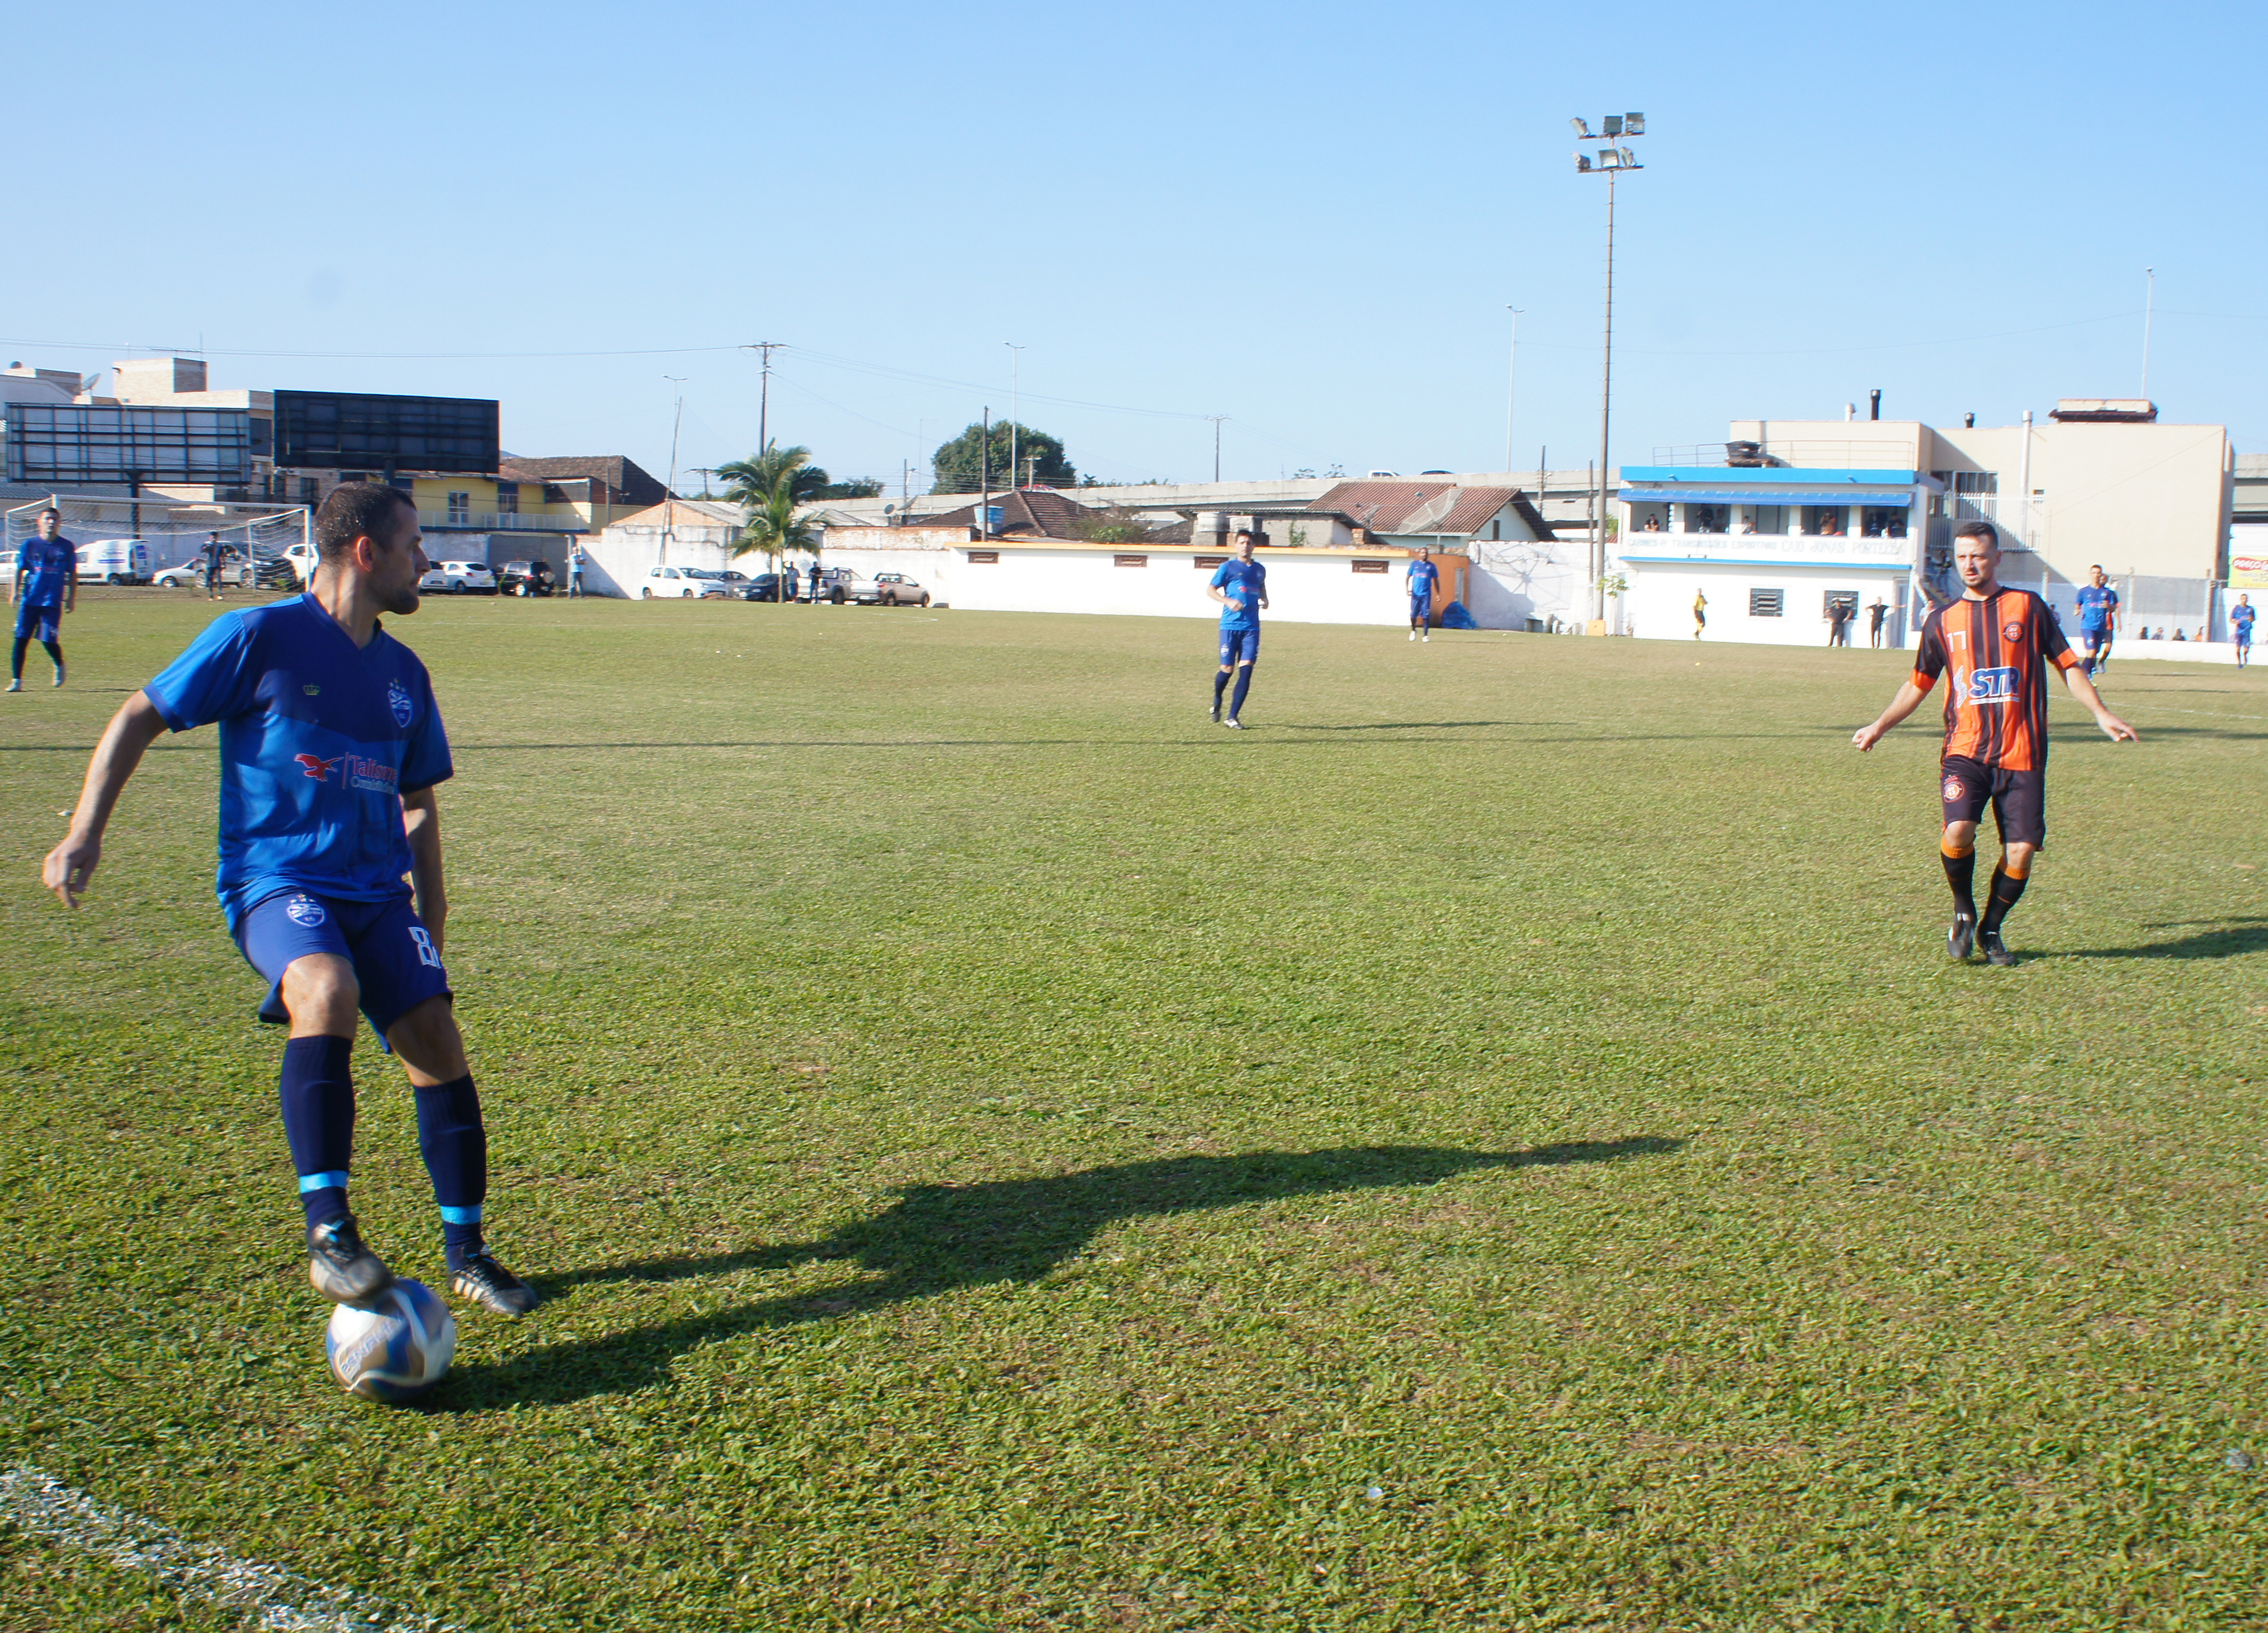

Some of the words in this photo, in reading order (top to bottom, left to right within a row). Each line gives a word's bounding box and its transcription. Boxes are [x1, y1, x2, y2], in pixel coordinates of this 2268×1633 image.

[1781, 540, 1804, 552] CAIO
[1810, 541, 1846, 554] JONAS
[1946, 630, 1967, 653] 17
[1968, 666, 2020, 698] STR
